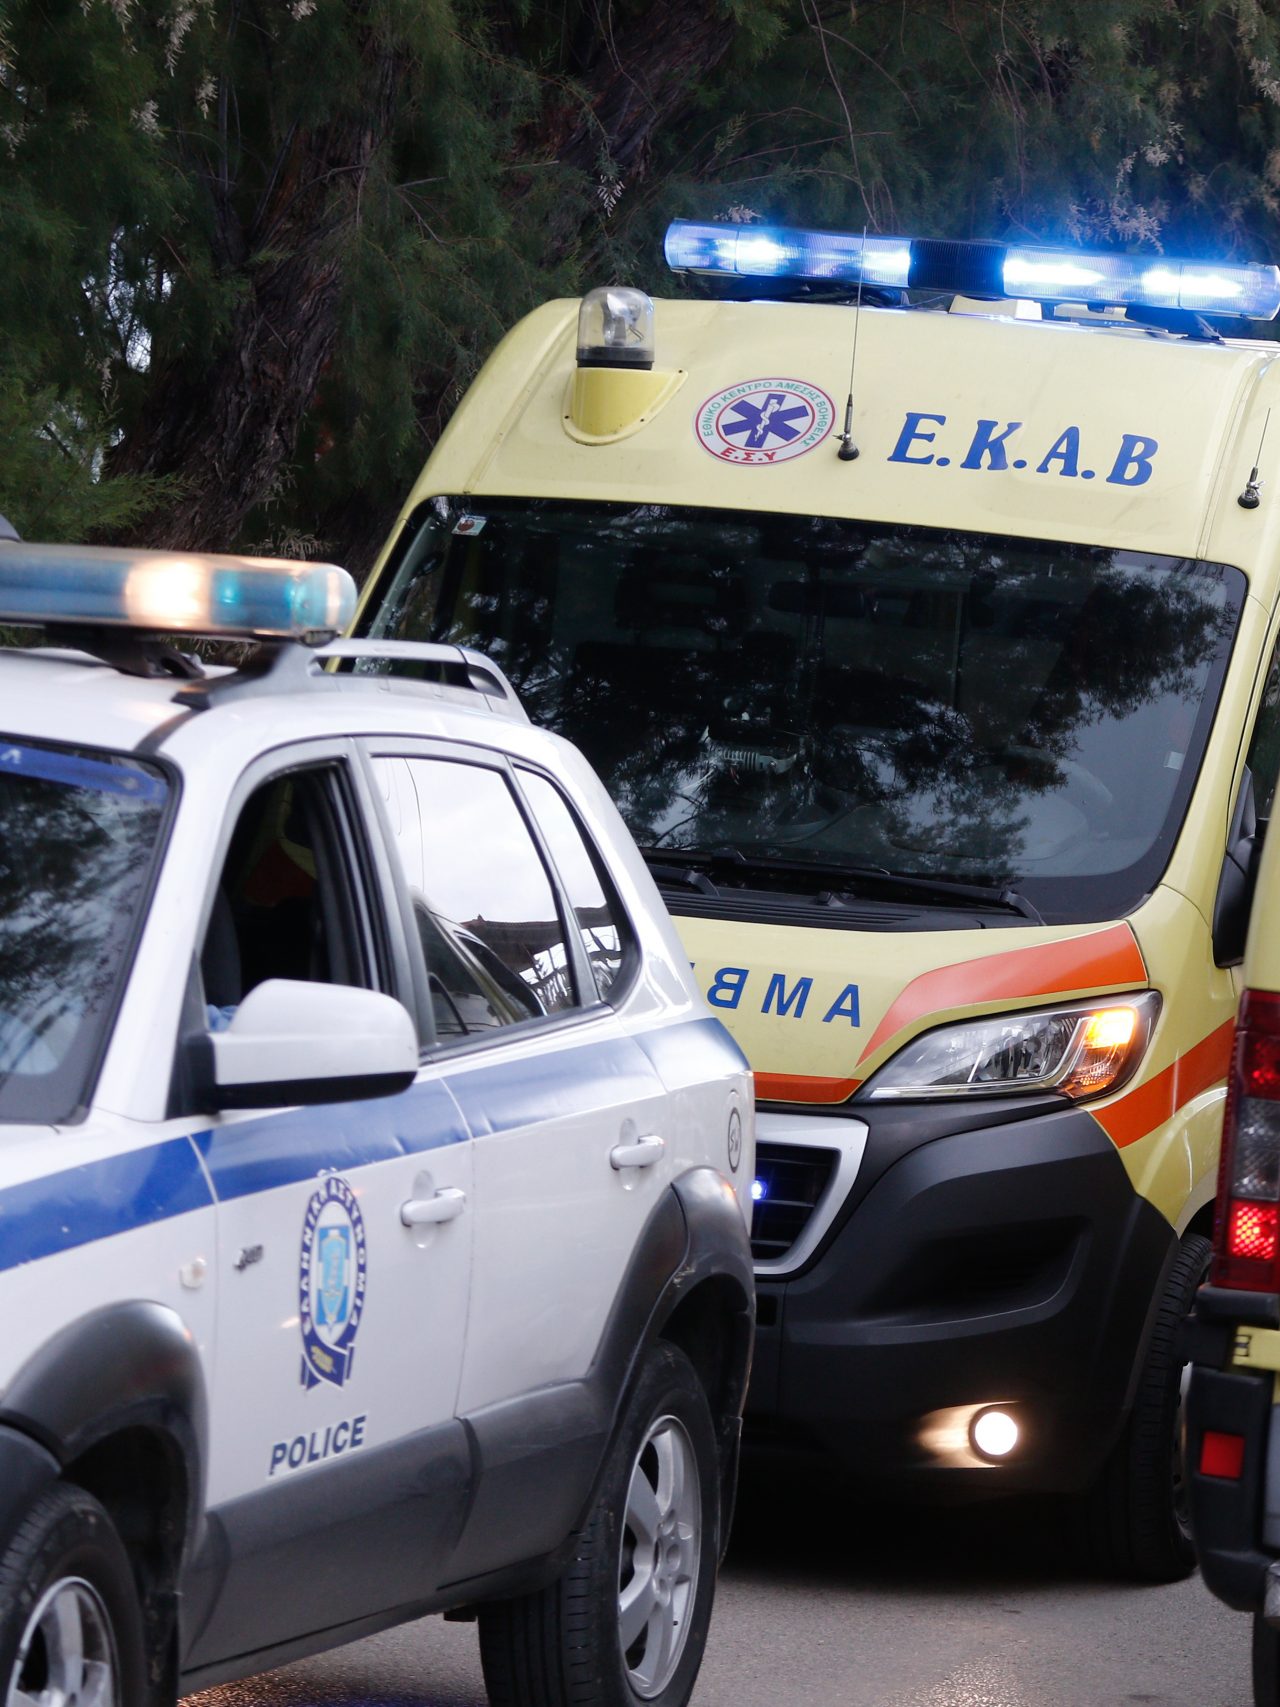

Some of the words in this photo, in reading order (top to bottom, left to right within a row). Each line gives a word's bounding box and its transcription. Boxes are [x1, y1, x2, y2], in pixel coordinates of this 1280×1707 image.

[702, 401, 722, 437] ΕΘΝΙΚΟ
[721, 381, 772, 403] ΚΕΝΤΡΟ
[775, 381, 821, 402] ΑΜΕΣΗΣ
[801, 400, 829, 447] ΒΟΗΘΕΙΑΣ
[269, 1415, 366, 1476] POLICE
